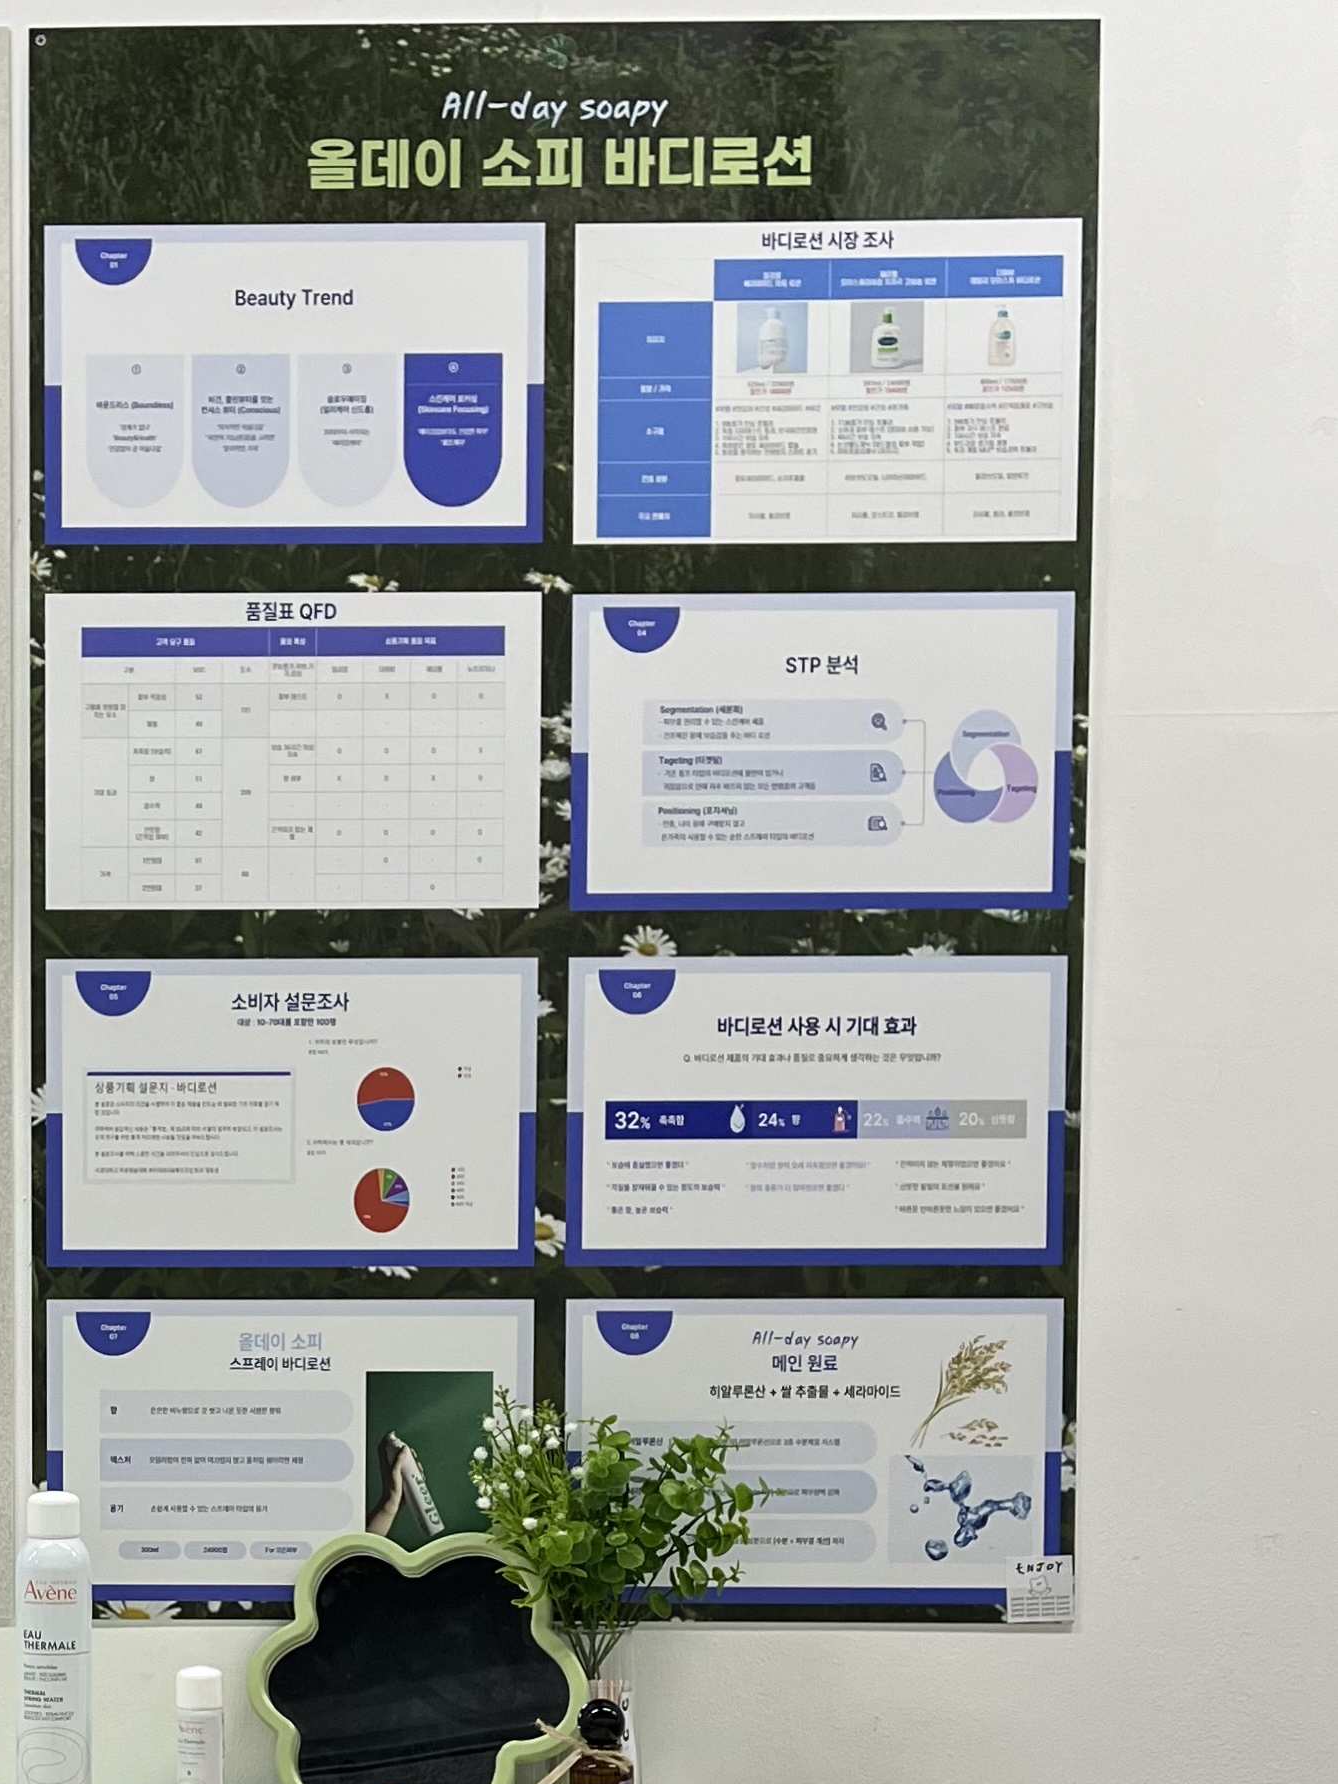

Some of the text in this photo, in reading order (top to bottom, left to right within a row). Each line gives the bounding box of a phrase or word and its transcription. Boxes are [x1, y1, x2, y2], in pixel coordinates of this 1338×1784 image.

[441, 89, 669, 129] All-day soapy
[307, 135, 812, 190] 올데이 소피 바디로션
[761, 230, 895, 251] 바디로션 시장 조사
[235, 288, 354, 311] Beauty Trend
[245, 601, 337, 622] 품질표 QFD
[785, 654, 858, 675] STP 분석
[230, 991, 350, 1013] 소비자 설문조사
[717, 1015, 918, 1037] 바디로션 사용 시 기대 효과
[94, 1081, 217, 1095] 상품기획 설문지 바디로션
[238, 1331, 322, 1352] 올데이 소피
[751, 1330, 859, 1350] All-day soapy
[229, 1356, 331, 1372] 스프레이 바디로션
[772, 1353, 839, 1373] 메인 원료
[1015, 1560, 1064, 1576] ENJOY
[24, 1579, 78, 1601] Avène
[23, 1629, 42, 1640] EAU
[23, 1640, 76, 1651] THERMALE
